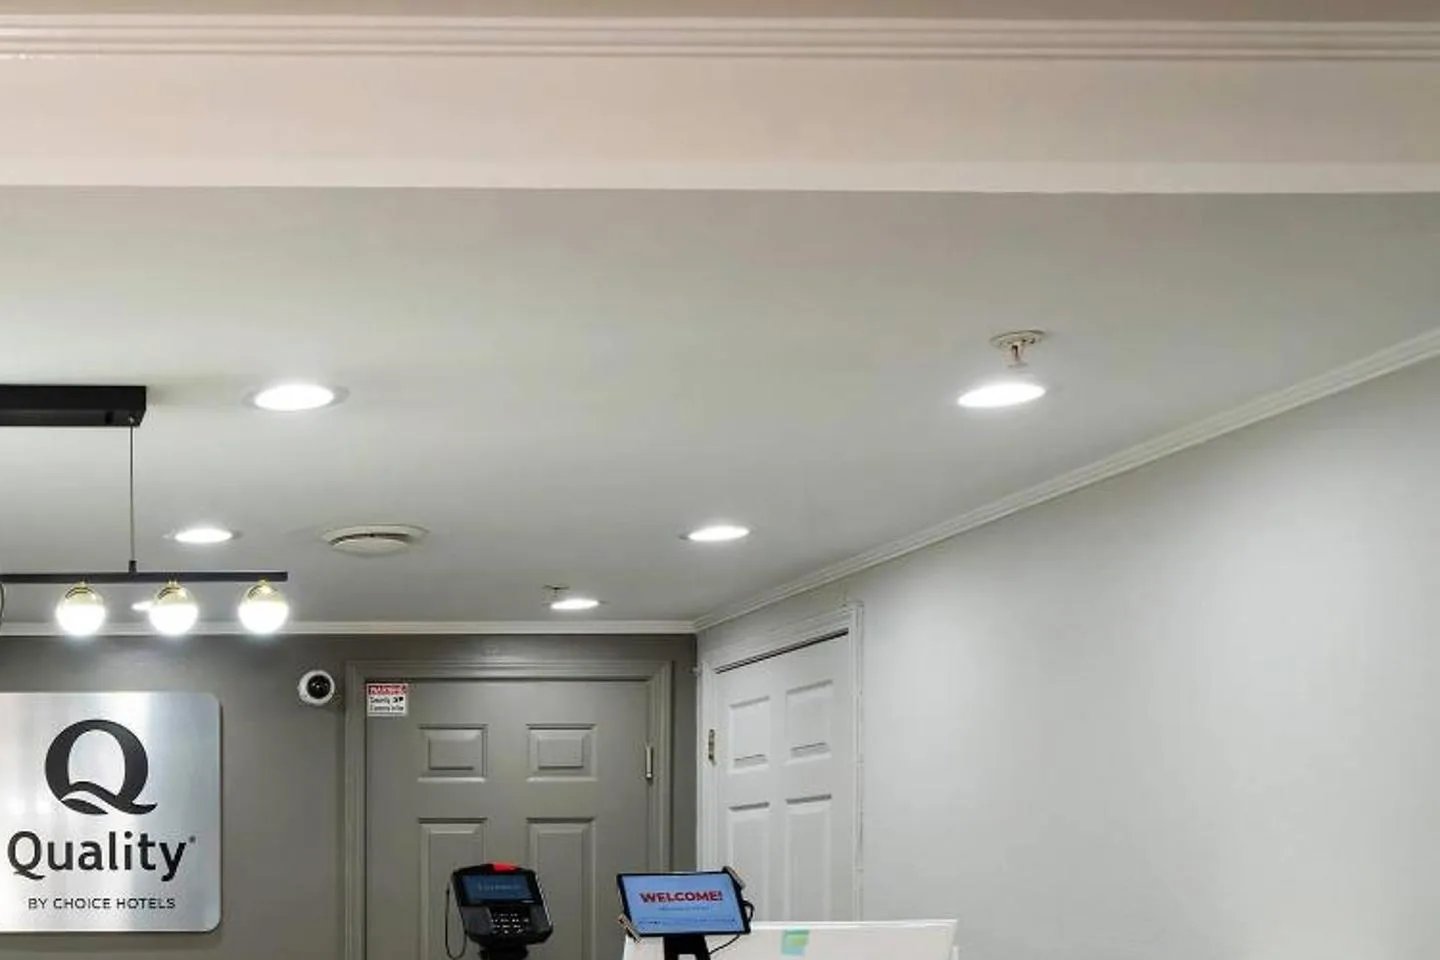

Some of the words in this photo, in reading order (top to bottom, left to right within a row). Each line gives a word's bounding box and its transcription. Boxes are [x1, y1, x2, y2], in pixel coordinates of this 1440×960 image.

[45, 719, 158, 815] Q
[7, 830, 187, 882] Quality
[28, 897, 48, 909] BY
[52, 897, 111, 910] CHOICE
[116, 897, 176, 910] HOTELS
[639, 890, 724, 904] WELCOME!
